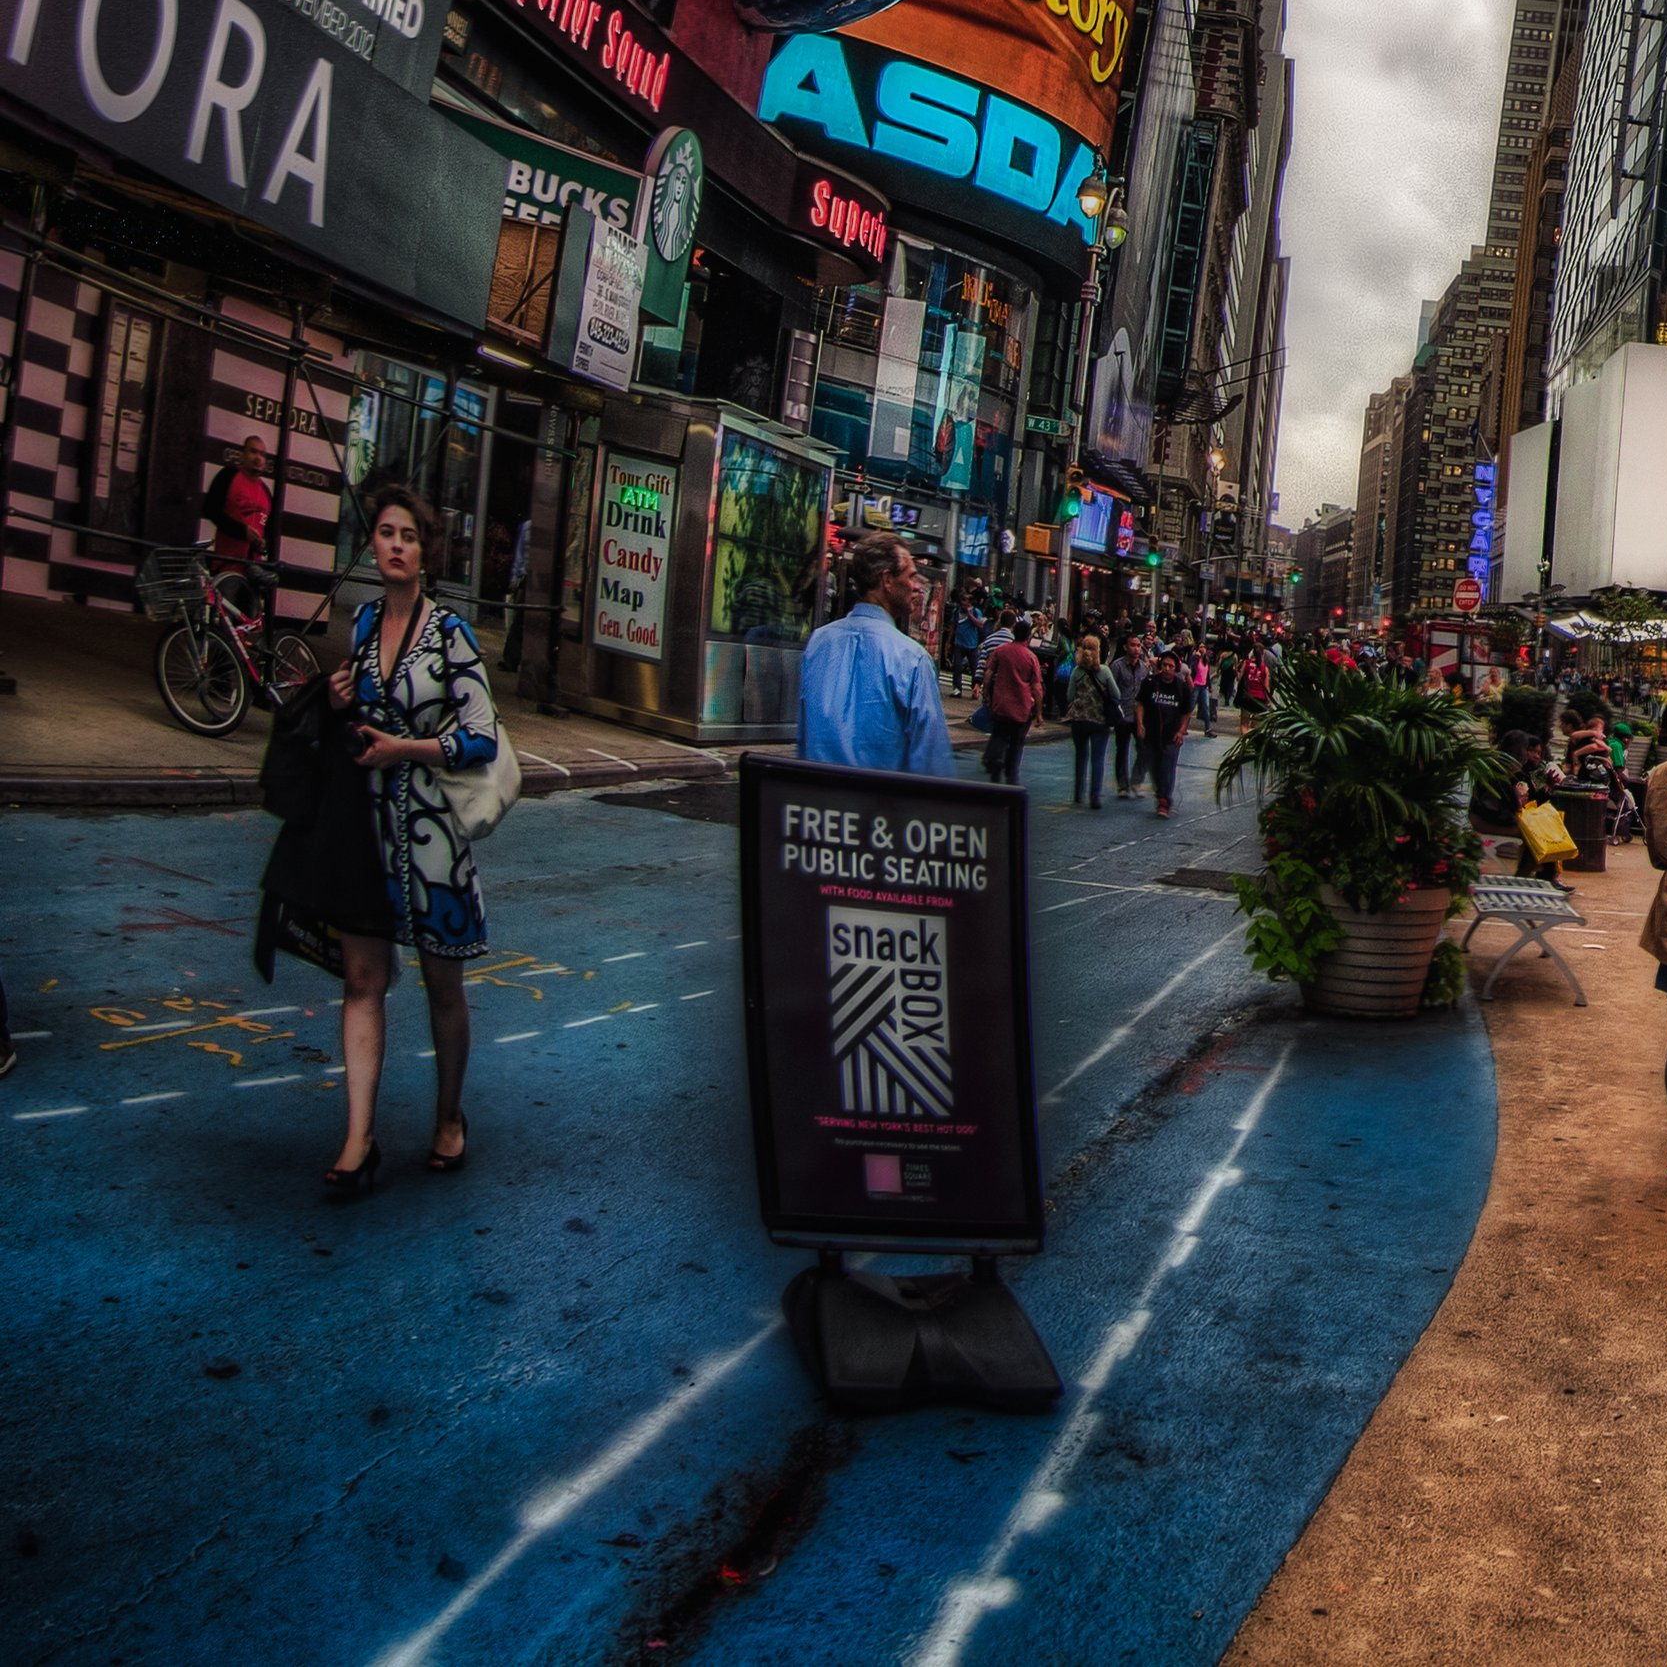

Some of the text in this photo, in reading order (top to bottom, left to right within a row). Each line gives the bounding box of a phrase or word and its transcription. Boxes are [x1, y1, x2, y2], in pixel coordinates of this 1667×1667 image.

[347, 20, 376, 62] 2012
[600, 9, 670, 113] Sound
[1028, 418, 1051, 432] W 43
[611, 465, 671, 496] Tour Gift
[622, 487, 660, 511] ATM
[606, 500, 667, 539] Drink
[603, 538, 663, 582] Candy
[600, 577, 644, 612] Map
[598, 611, 623, 639] Gen.
[782, 803, 988, 861] FREE & OPEN
[782, 843, 988, 892] PUBLIC SEATING
[820, 885, 954, 909] WITH FOOD AVAILABLE FROM
[832, 919, 940, 967] snack
[901, 967, 945, 1043] BOX
[858, 1119, 878, 1130] NEW
[913, 1123, 934, 1134] BEST
